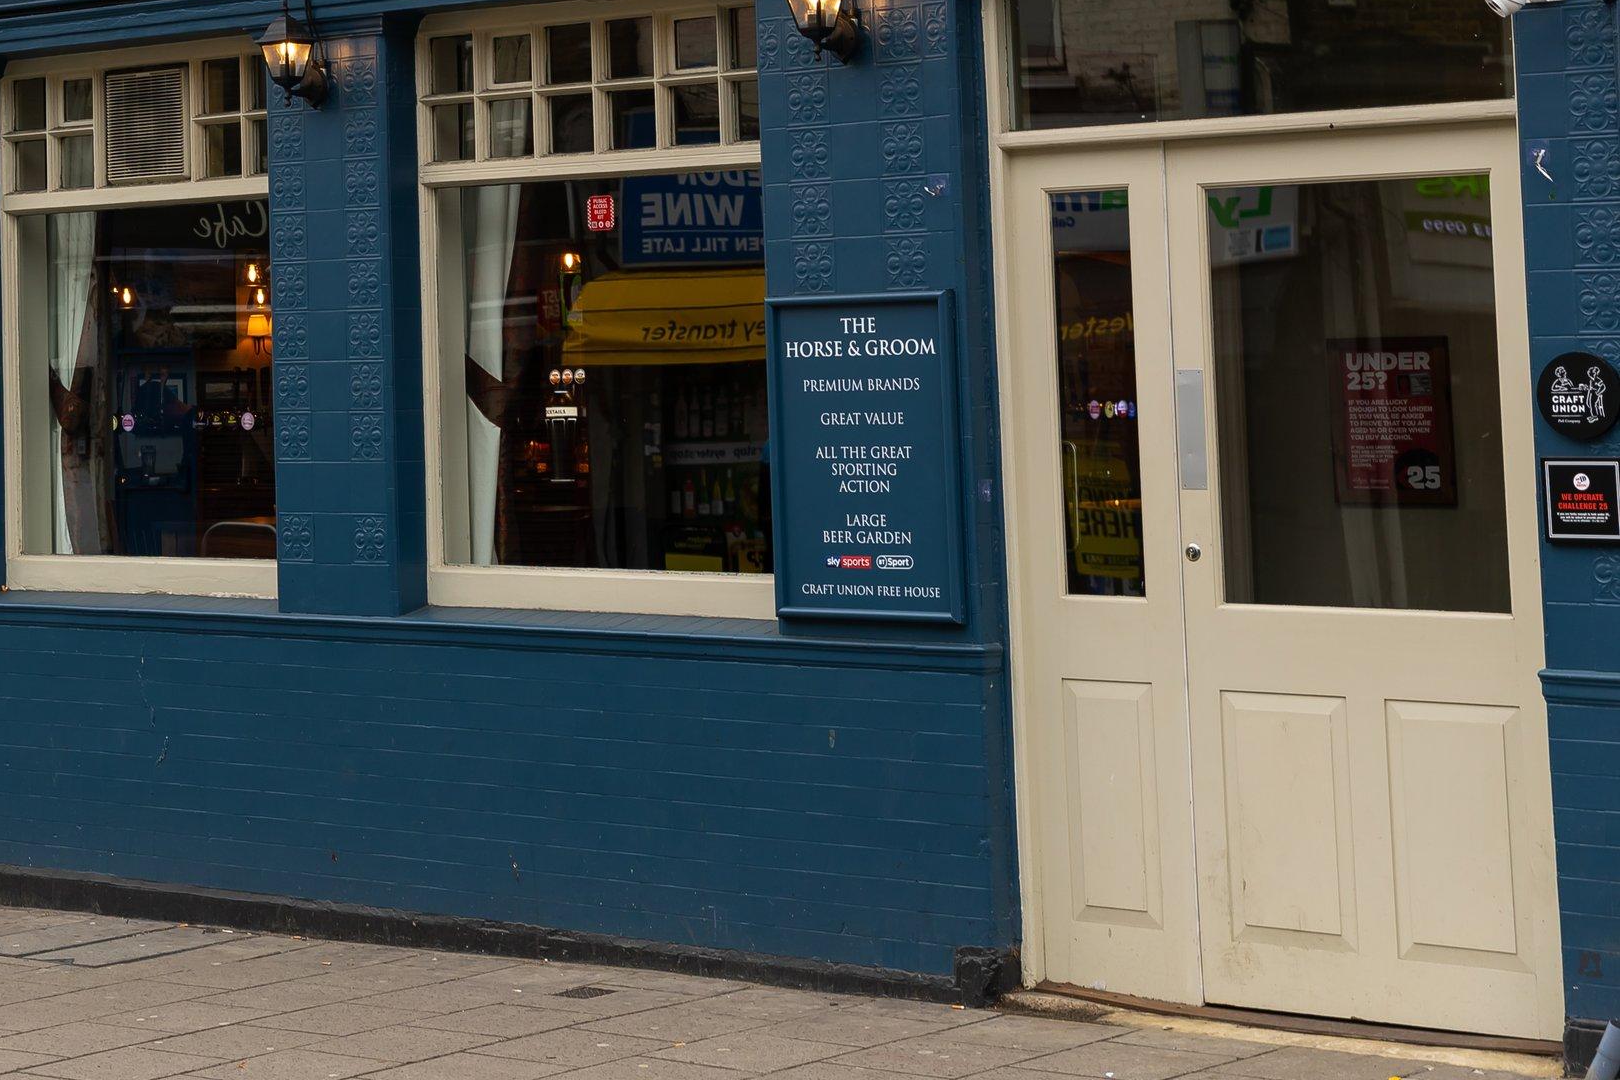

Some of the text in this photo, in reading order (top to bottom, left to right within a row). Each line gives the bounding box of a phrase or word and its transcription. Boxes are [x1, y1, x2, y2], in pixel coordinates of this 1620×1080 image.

[840, 317, 876, 334] THE
[786, 338, 936, 358] HORSE & GROOM
[1345, 351, 1431, 371] UNDER
[803, 377, 920, 392] PREMIUM BRANDS
[1346, 371, 1388, 391] 25?
[1552, 395, 1585, 404] CRAFT
[1552, 405, 1586, 413] UNION
[821, 412, 904, 426] GREAT VALUE
[816, 446, 912, 459] ALL THE GREAT
[831, 463, 897, 476] SPORTING
[1407, 465, 1441, 490] 25
[839, 480, 890, 493] ACTION
[1558, 502, 1597, 510] CHALLENGE
[846, 513, 887, 527] LARGE
[823, 530, 912, 544] BEER GARDEN
[827, 557, 870, 567] sky sports
[887, 557, 909, 567] Sport
[802, 583, 941, 598] CRAFT UNION FREE HOUSE
